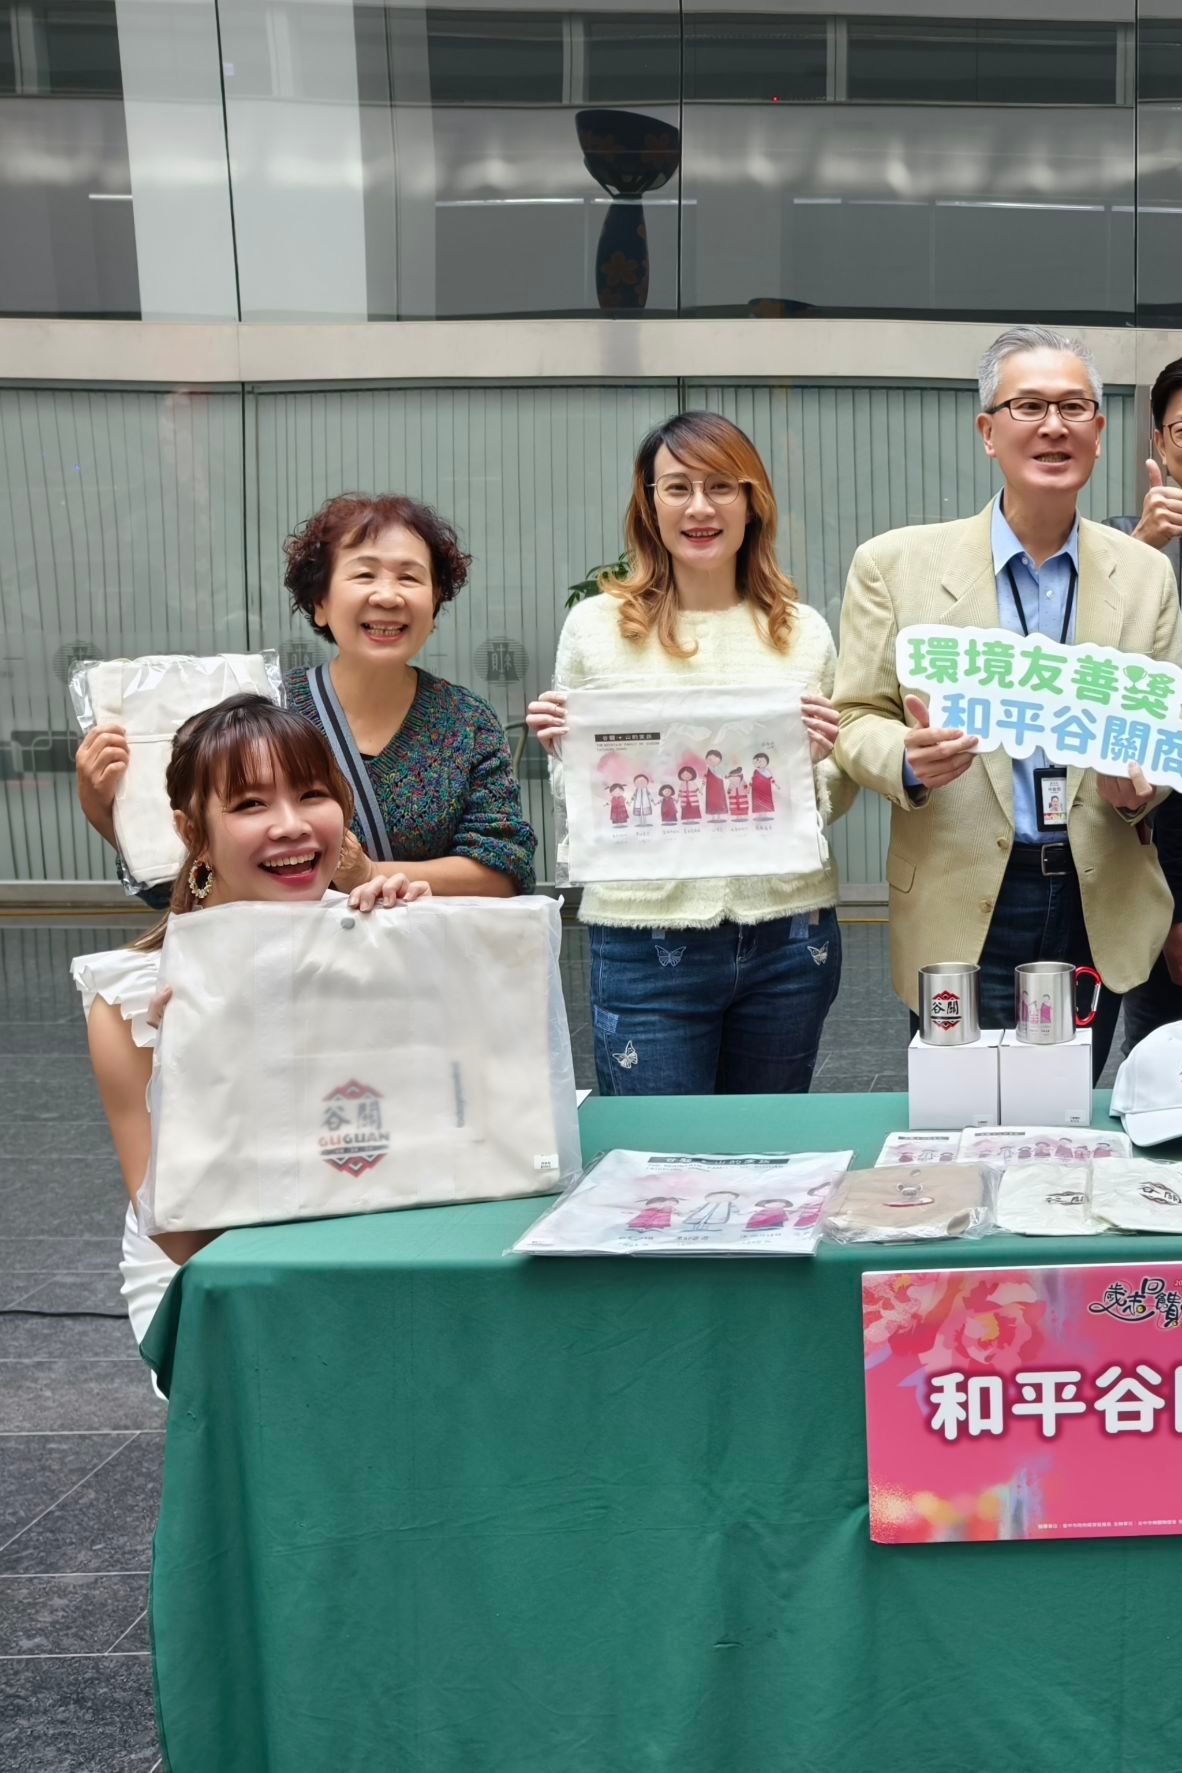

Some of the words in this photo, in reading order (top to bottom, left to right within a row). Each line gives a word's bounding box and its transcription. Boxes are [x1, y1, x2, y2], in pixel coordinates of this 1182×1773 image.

[932, 1000, 959, 1015] 谷關
[320, 1100, 383, 1131] 谷關
[318, 1132, 390, 1148] GUGUAN
